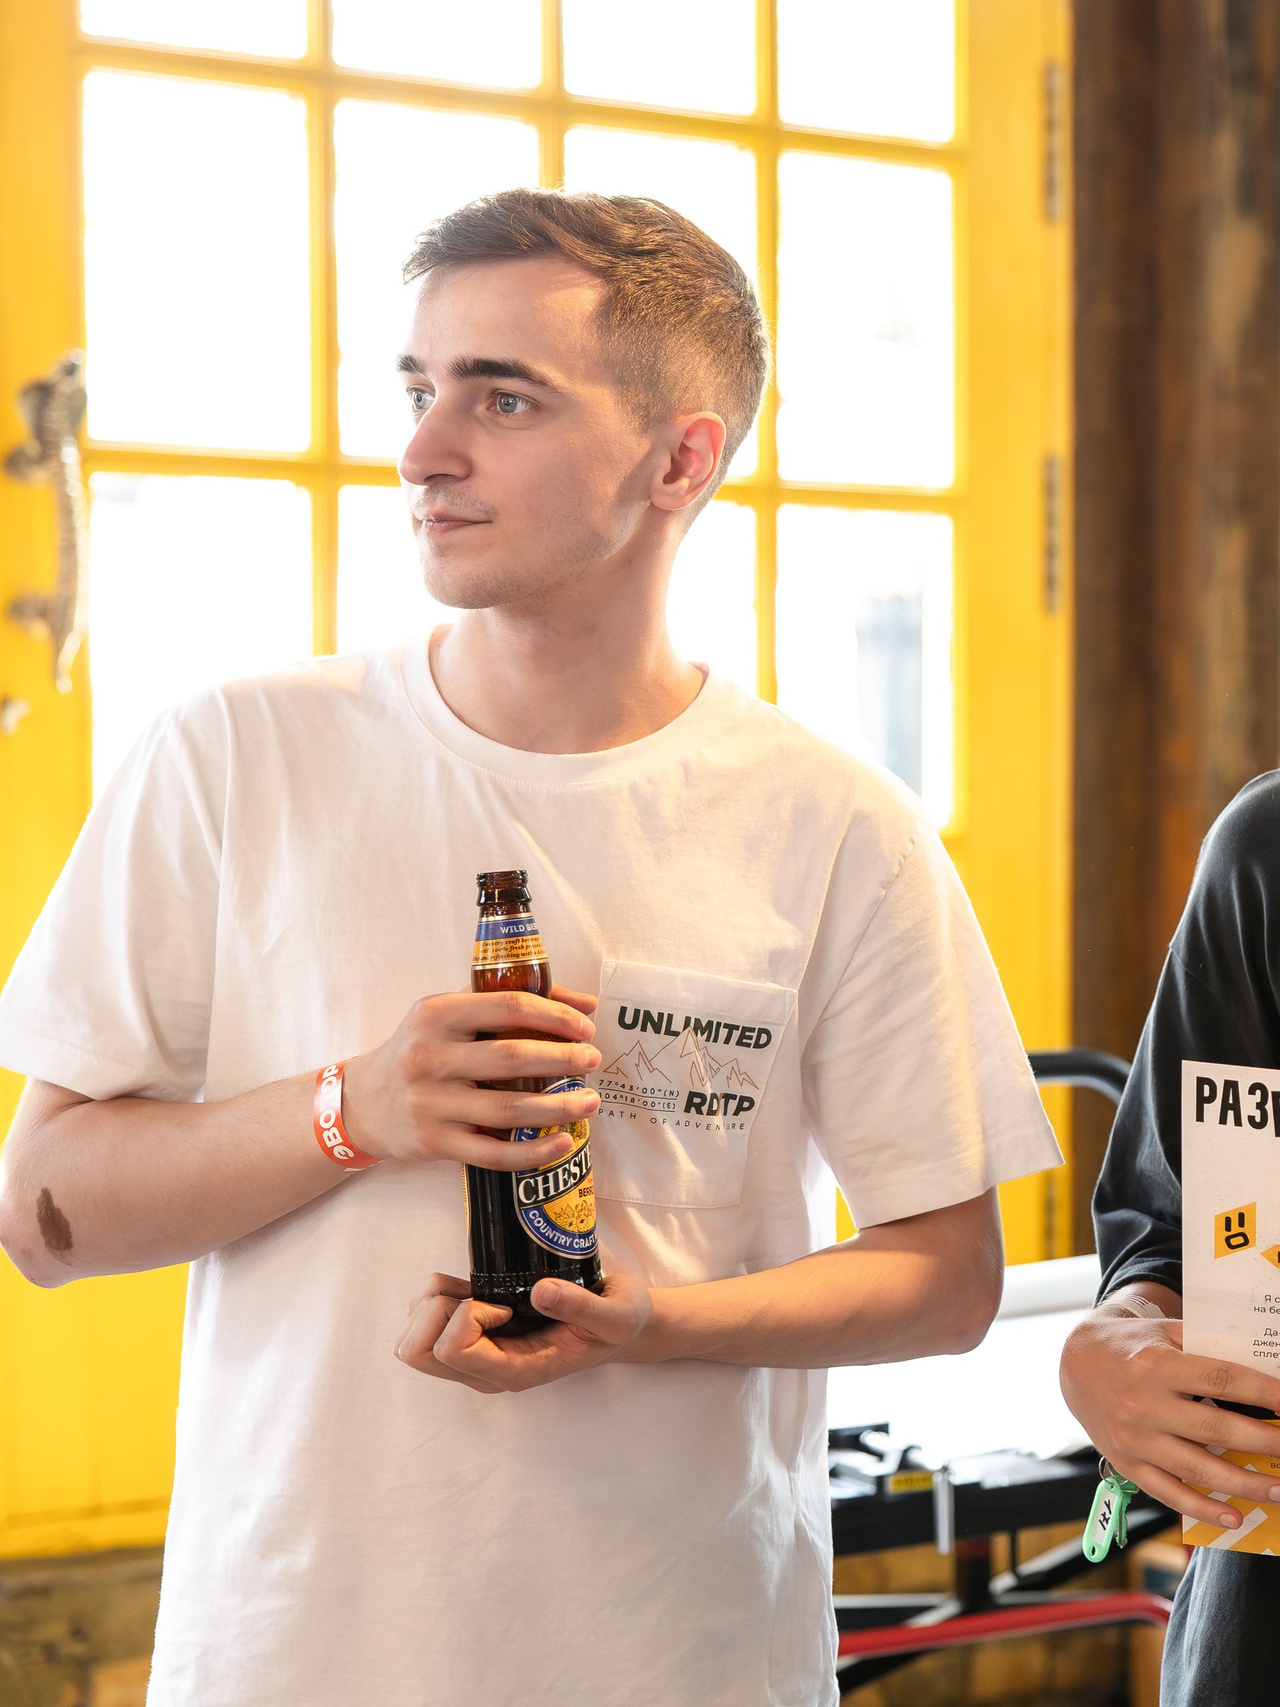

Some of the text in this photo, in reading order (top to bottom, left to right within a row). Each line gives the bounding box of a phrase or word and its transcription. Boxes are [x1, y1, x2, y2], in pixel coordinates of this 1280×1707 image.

[500, 924, 525, 934] WILD
[617, 1005, 772, 1050] UNLIMITED
[319, 1064, 355, 1160] ЭВООР
[598, 1108, 637, 1120] PATH
[649, 1117, 667, 1125] OF
[518, 1141, 592, 1204] CHESTE
[529, 1210, 596, 1249] COUNTRY CRAFT
[1253, 1305, 1266, 1313] на
[1264, 1294, 1272, 1303] Я
